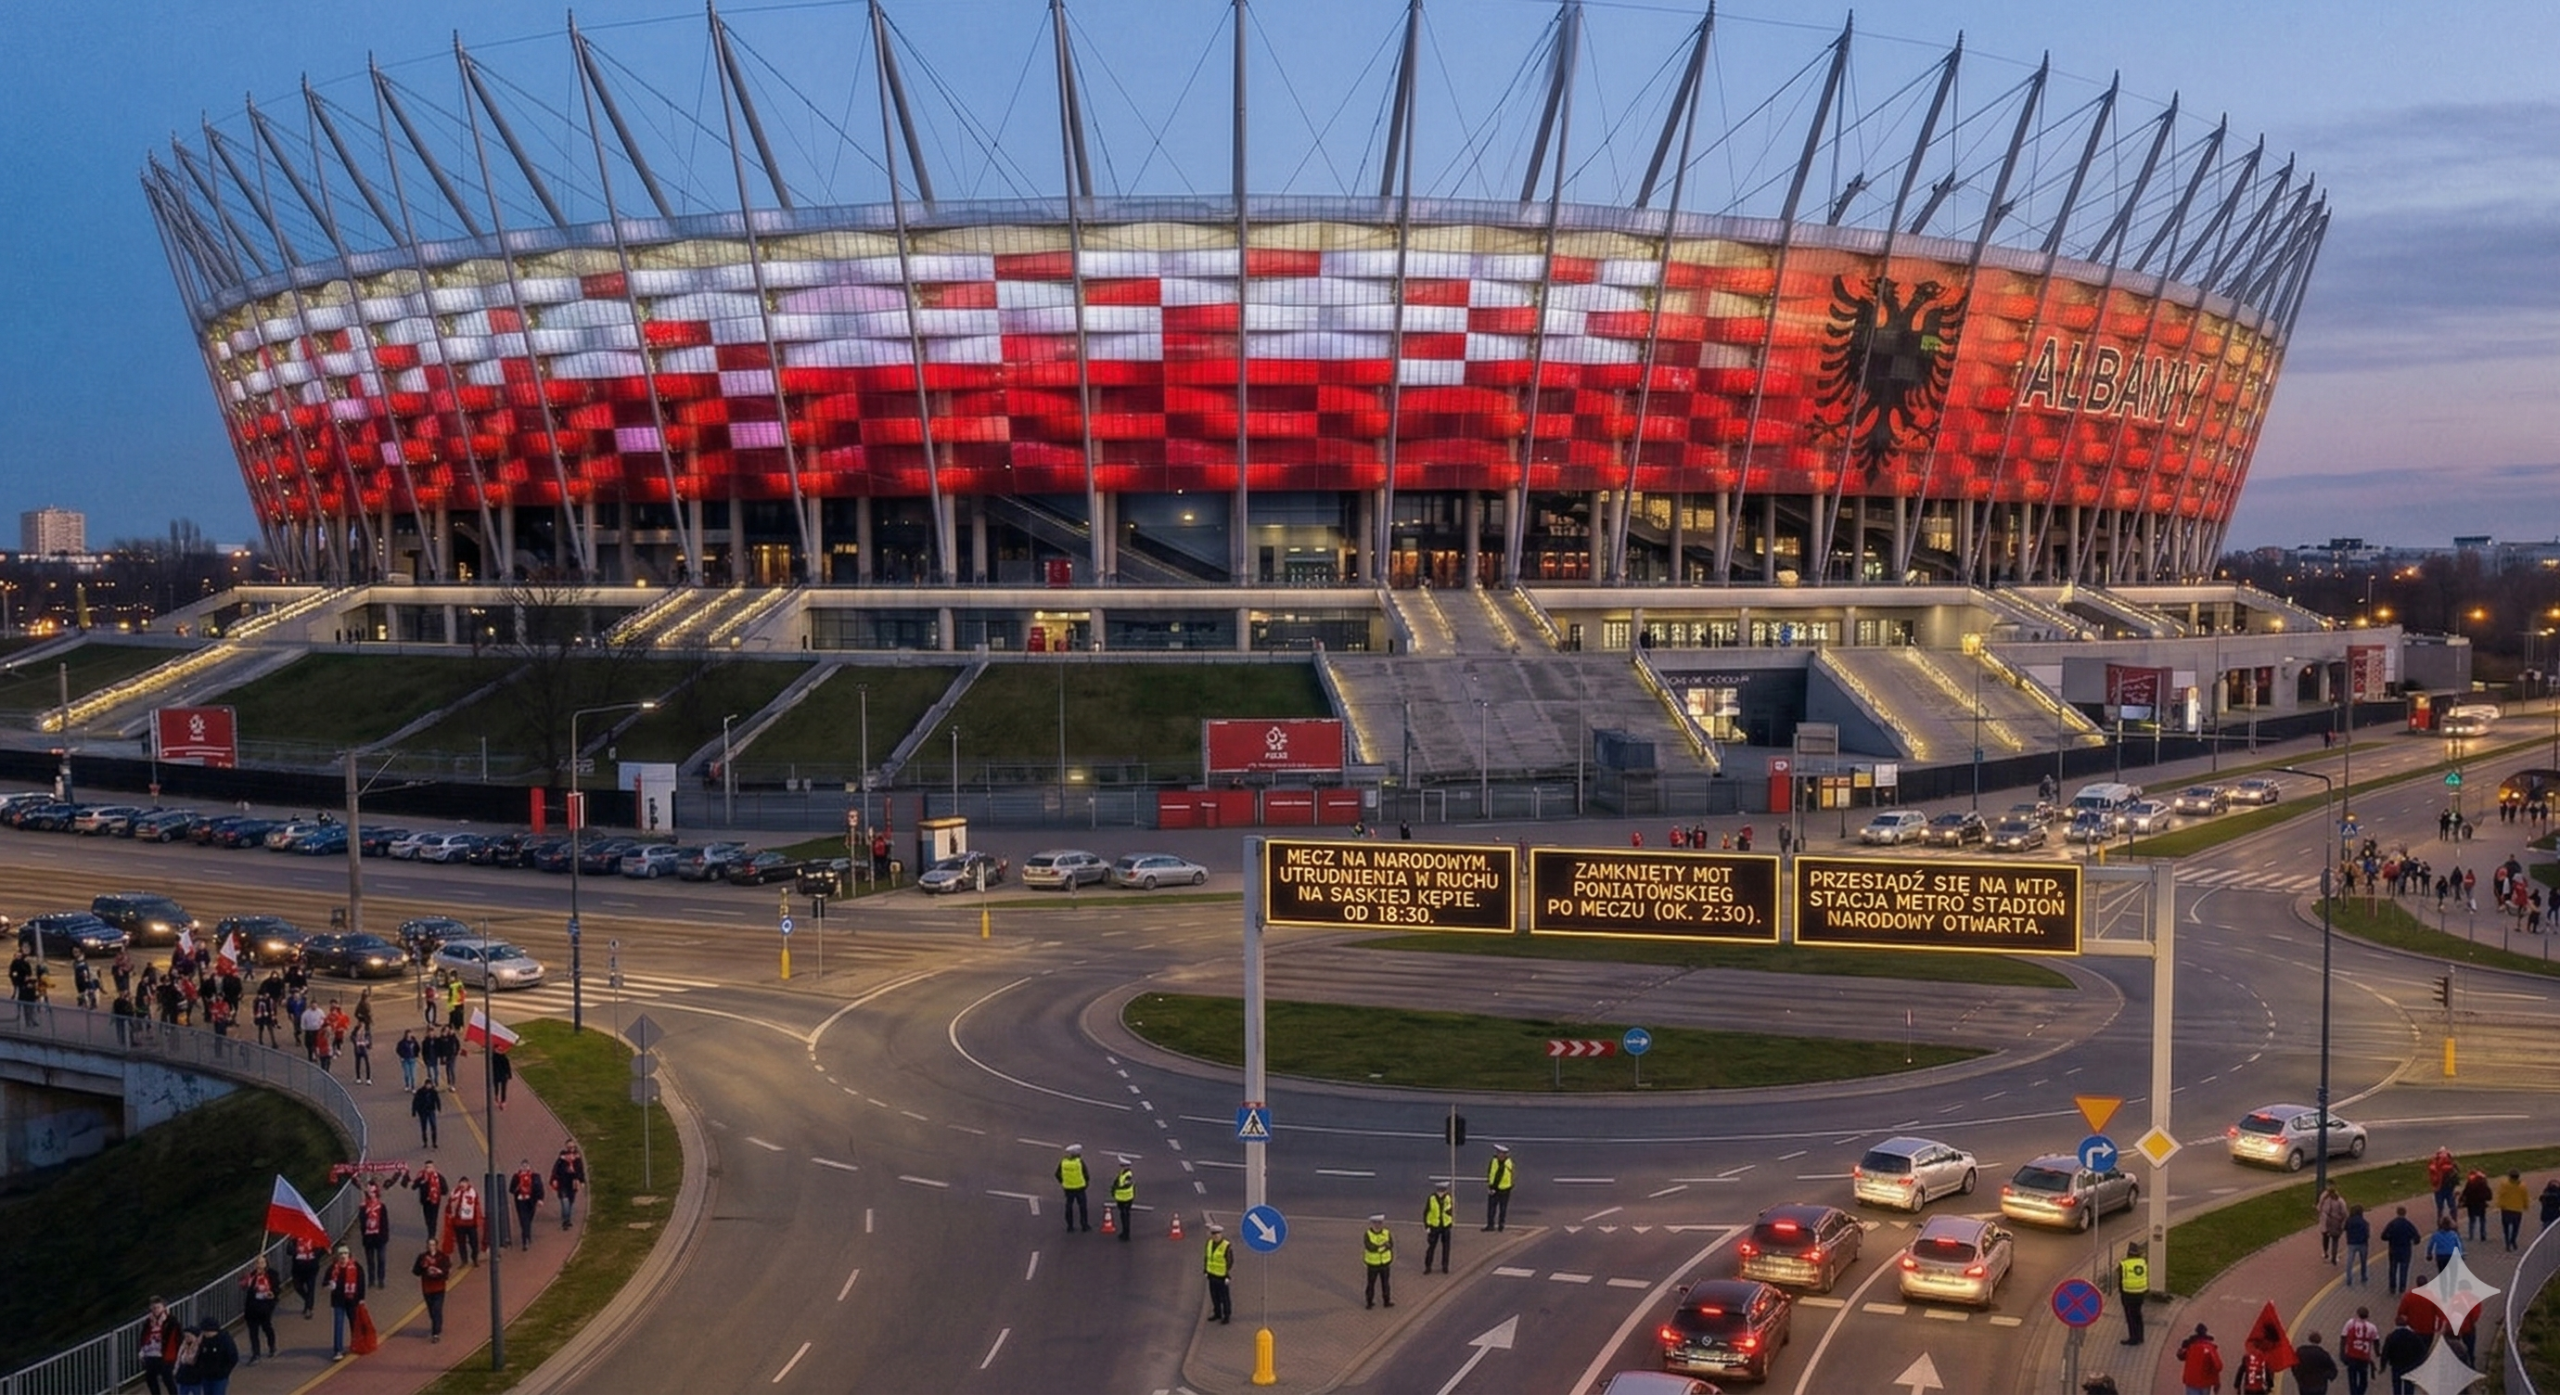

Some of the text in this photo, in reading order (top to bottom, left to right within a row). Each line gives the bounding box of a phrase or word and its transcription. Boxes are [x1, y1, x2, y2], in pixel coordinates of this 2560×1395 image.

[2019, 336, 2207, 427] ALBANY
[1287, 849, 1492, 871] MECZ NA NARODOWYM.
[1280, 867, 1499, 890] UTRUDNIENIA W RUCHU
[1574, 862, 1733, 884] ZAMKNIĘTY MOT
[1809, 869, 1925, 893] PRZESIĄDŹ
[1933, 876, 1971, 897] SIĘ
[1979, 877, 2008, 894] NA
[1298, 886, 1481, 909] NA SASKIEJ KĘPIE.
[1809, 890, 2065, 916] STACJA METRO STADION
[1344, 905, 1435, 924] OD 18:30.
[1548, 899, 1762, 926] PO MECZU (OK. 2:30).
[1827, 911, 2045, 935] NARODOWY OTWARTA.
